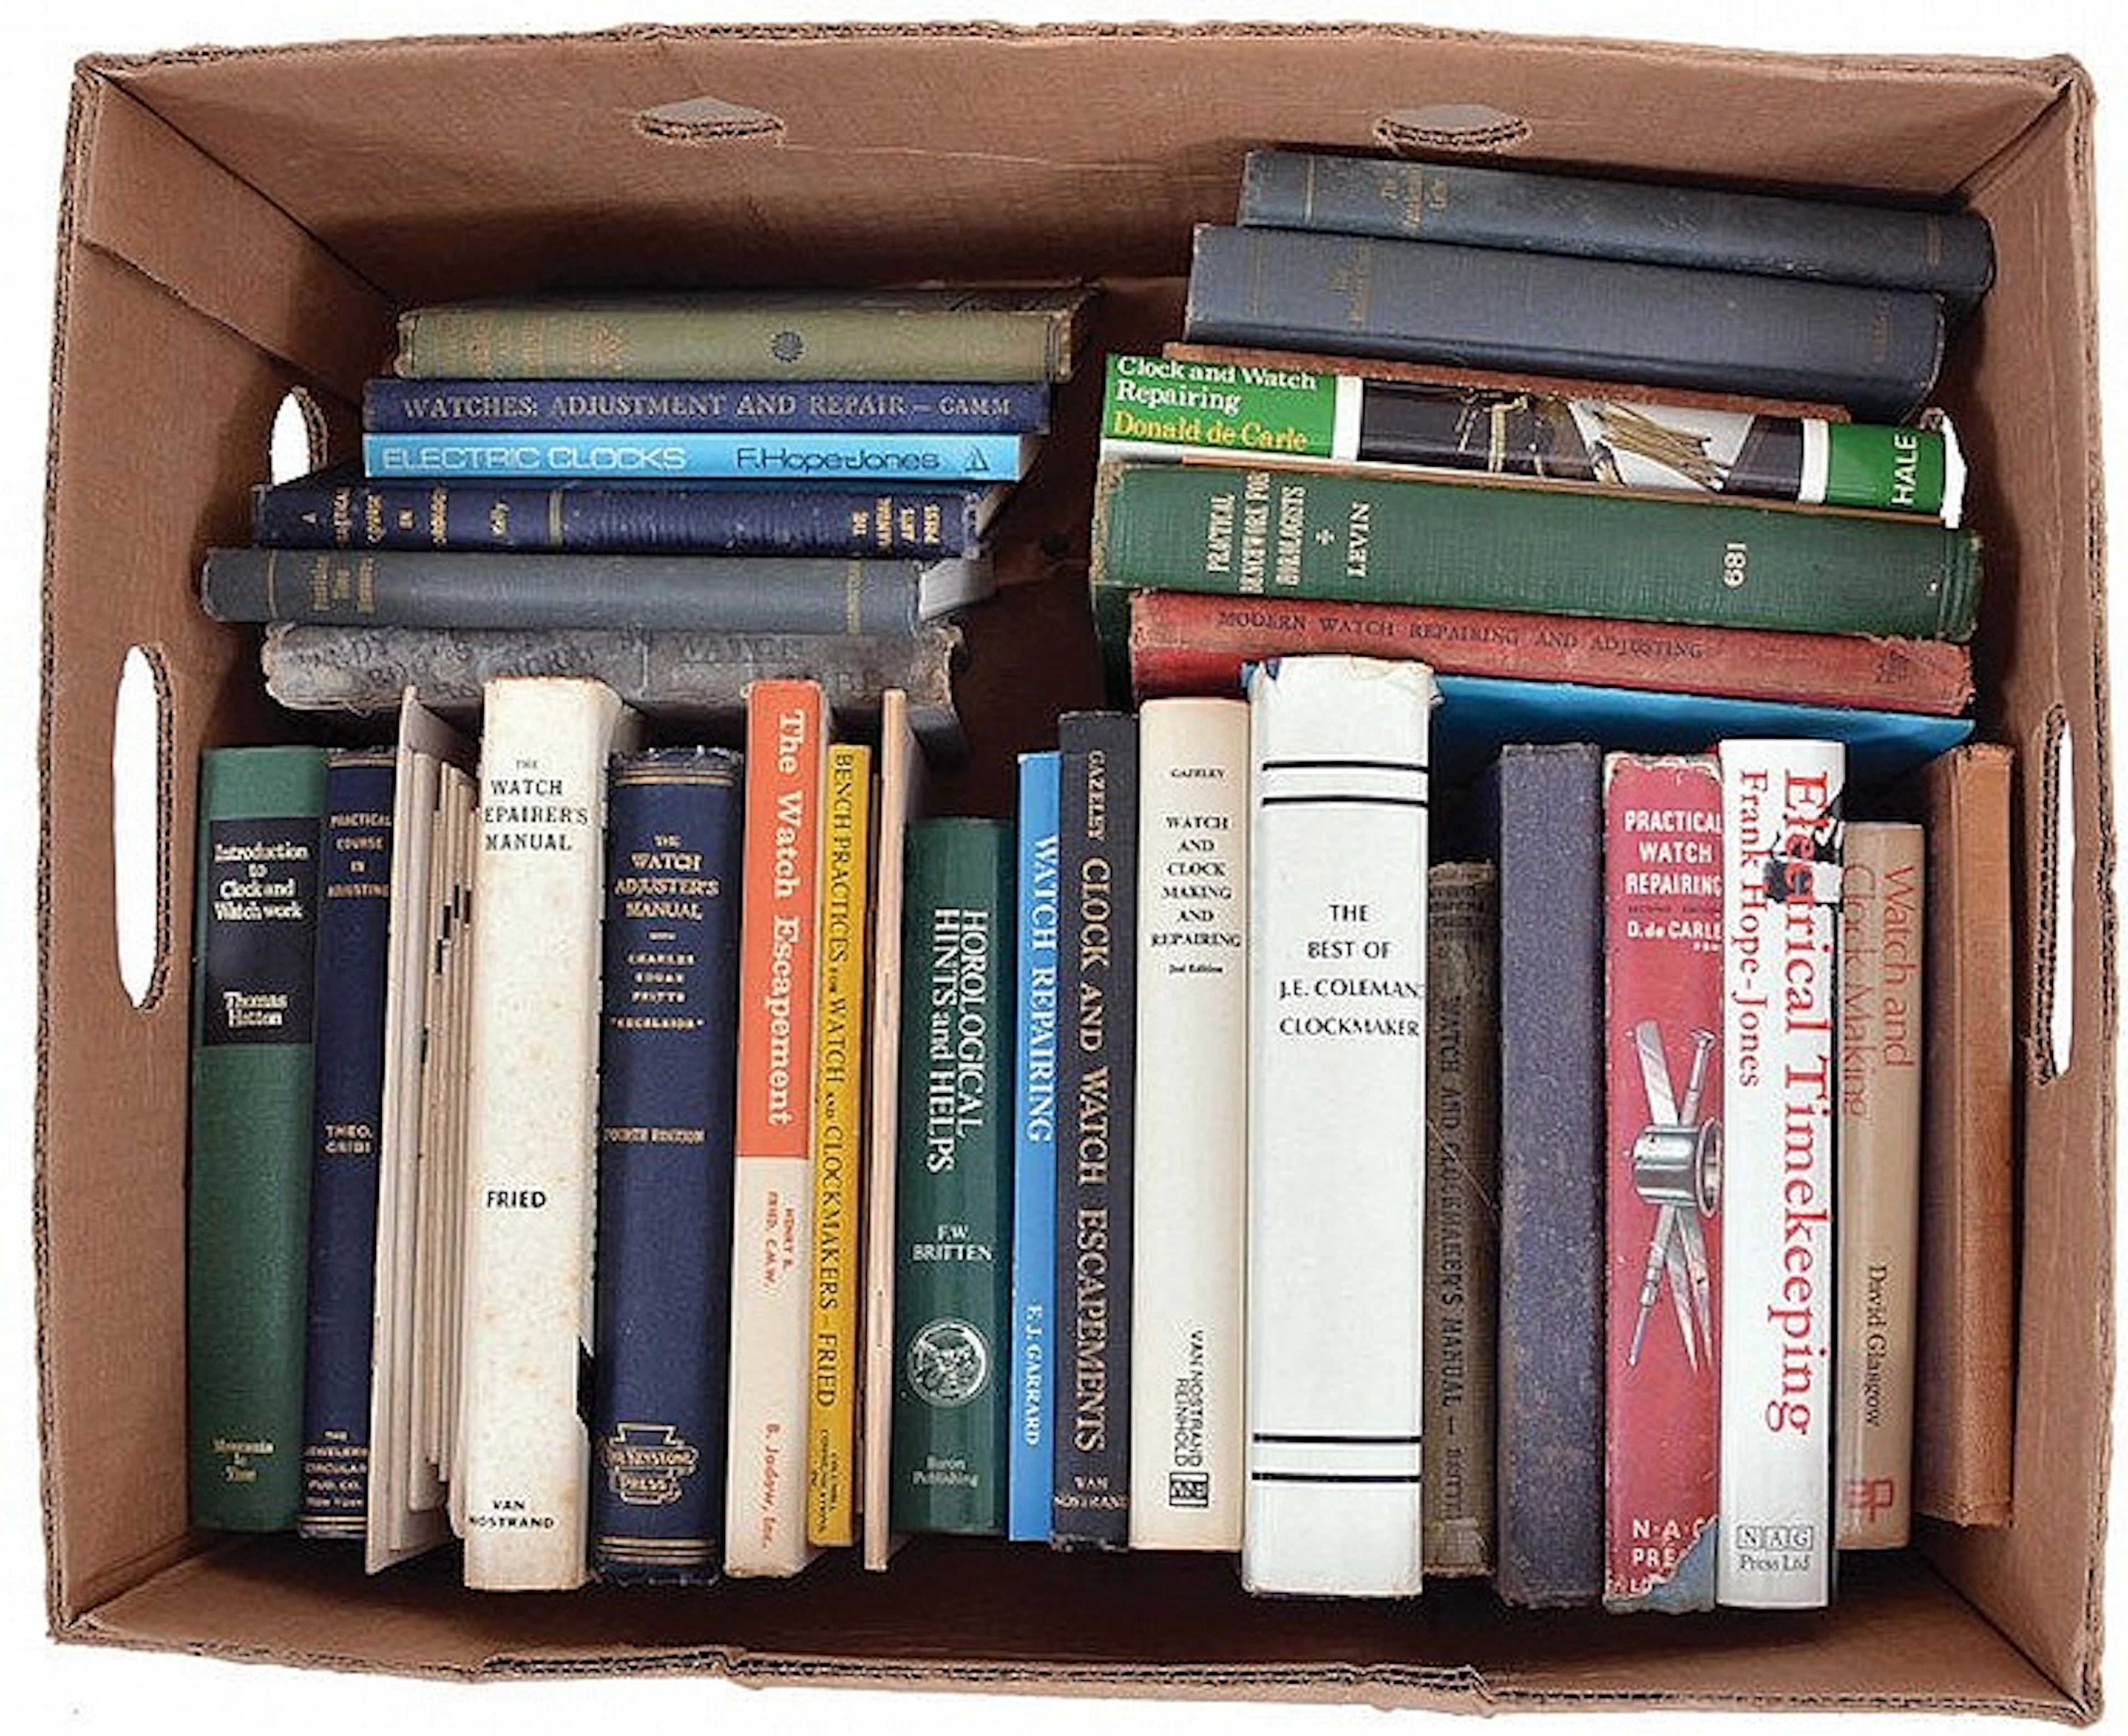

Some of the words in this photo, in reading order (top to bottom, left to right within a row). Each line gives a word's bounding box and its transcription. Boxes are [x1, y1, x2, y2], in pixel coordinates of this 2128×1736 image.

[1118, 356, 1189, 378] Clock
[1194, 361, 1235, 383] and
[1242, 367, 1317, 390] Watch
[403, 395, 537, 419] WATCHES:
[553, 394, 726, 417] ADJUSTMENT
[736, 395, 795, 416] AND
[809, 395, 906, 416] REPAIR
[939, 399, 1012, 416] CAMM
[1116, 380, 1241, 416] Repairing
[1113, 411, 1201, 442] Donald
[1208, 419, 1235, 442] de
[1242, 425, 1307, 452] Carle
[382, 447, 540, 470] ELECTRIC
[548, 447, 686, 470] CLOCKS
[1892, 434, 1918, 505] HALE
[1347, 501, 1372, 577] LEVIN
[1723, 543, 1747, 588] 681
[1220, 612, 1305, 632] MODERN
[1319, 618, 1394, 637] WATCH
[1410, 624, 1520, 646] REPAIRING
[1535, 632, 1577, 648] AND
[1590, 638, 1704, 659] ADJUSTING
[779, 709, 805, 774] The
[491, 780, 563, 795] WATCH
[833, 754, 854, 829] BENCH
[1087, 749, 1107, 841] GAZELEY
[484, 807, 589, 825] EPAIRER'S
[1166, 816, 1229, 829] WATCH
[1624, 810, 1722, 833] PRACTICAL
[1740, 770, 1773, 868] Frank
[214, 842, 309, 863] Introduction
[484, 833, 572, 852] MANUAL
[631, 853, 703, 872] WATCH
[775, 790, 804, 899] Watch
[1178, 839, 1215, 852] AND
[1639, 841, 1713, 864] WATCH
[248, 863, 268, 878] to
[1167, 862, 1226, 876] CLOCK
[1624, 872, 1722, 897] REPAIRING
[625, 901, 703, 921] MANUAL
[830, 837, 852, 962] PRACTICES
[1031, 834, 1059, 950] WATCH
[1080, 857, 1112, 971] CLOCK
[1163, 887, 1231, 900] MAKING
[1328, 904, 1368, 922] THE
[1782, 769, 1832, 1032] Electrical
[1178, 910, 1215, 923] AND
[1667, 920, 1722, 940] CARLE
[1843, 863, 1876, 974] Clock
[1883, 865, 1916, 986] Watch
[932, 908, 960, 1006] HINTS
[1151, 933, 1241, 948] REPAIRING
[1307, 941, 1355, 959] BEST
[1363, 941, 1392, 959] OF
[1189, 964, 1223, 974] Edition
[1279, 979, 1308, 1000] J.E.
[1731, 882, 1768, 1087] Hope-Jones
[223, 991, 288, 1010] Thomas
[228, 1010, 283, 1028] Hatton
[765, 915, 800, 1125] Escapement
[1078, 981, 1103, 1052] AND
[826, 998, 847, 1083] WATCH
[929, 1007, 955, 1061] and
[957, 909, 989, 1139] HOROLOGICAL
[1279, 1017, 1419, 1037] CLOCKMAKER
[1884, 997, 1915, 1068] and
[1026, 965, 1057, 1143] REPAIRING
[1843, 985, 1876, 1118] Making
[926, 1070, 955, 1174] HELPS
[1077, 1065, 1109, 1186] WATCH
[1441, 1087, 1463, 1129] AND
[487, 1190, 547, 1208] FRIED
[820, 1126, 843, 1310] CLOCKMAKERS
[912, 1244, 993, 1261] BRITTEN
[1766, 1054, 1832, 1435] Timekeeping
[1867, 1266, 1887, 1327] David
[1074, 1208, 1108, 1452] ESCAPEMENTS
[1190, 1330, 1204, 1366] VAN
[817, 1333, 837, 1408] FRIED
[1441, 1317, 1464, 1408] MANUAL
[1864, 1333, 1886, 1427] Glasgow
[1025, 1344, 1043, 1446] GARRARD
[1174, 1378, 1189, 1467] REINHOLD
[1189, 1370, 1204, 1467] NOSTRAND
[493, 1500, 525, 1510] VAN
[1633, 1548, 1677, 1567] PRE
[1740, 1554, 1780, 1570] Press
[1782, 1554, 1810, 1571] Ltd
